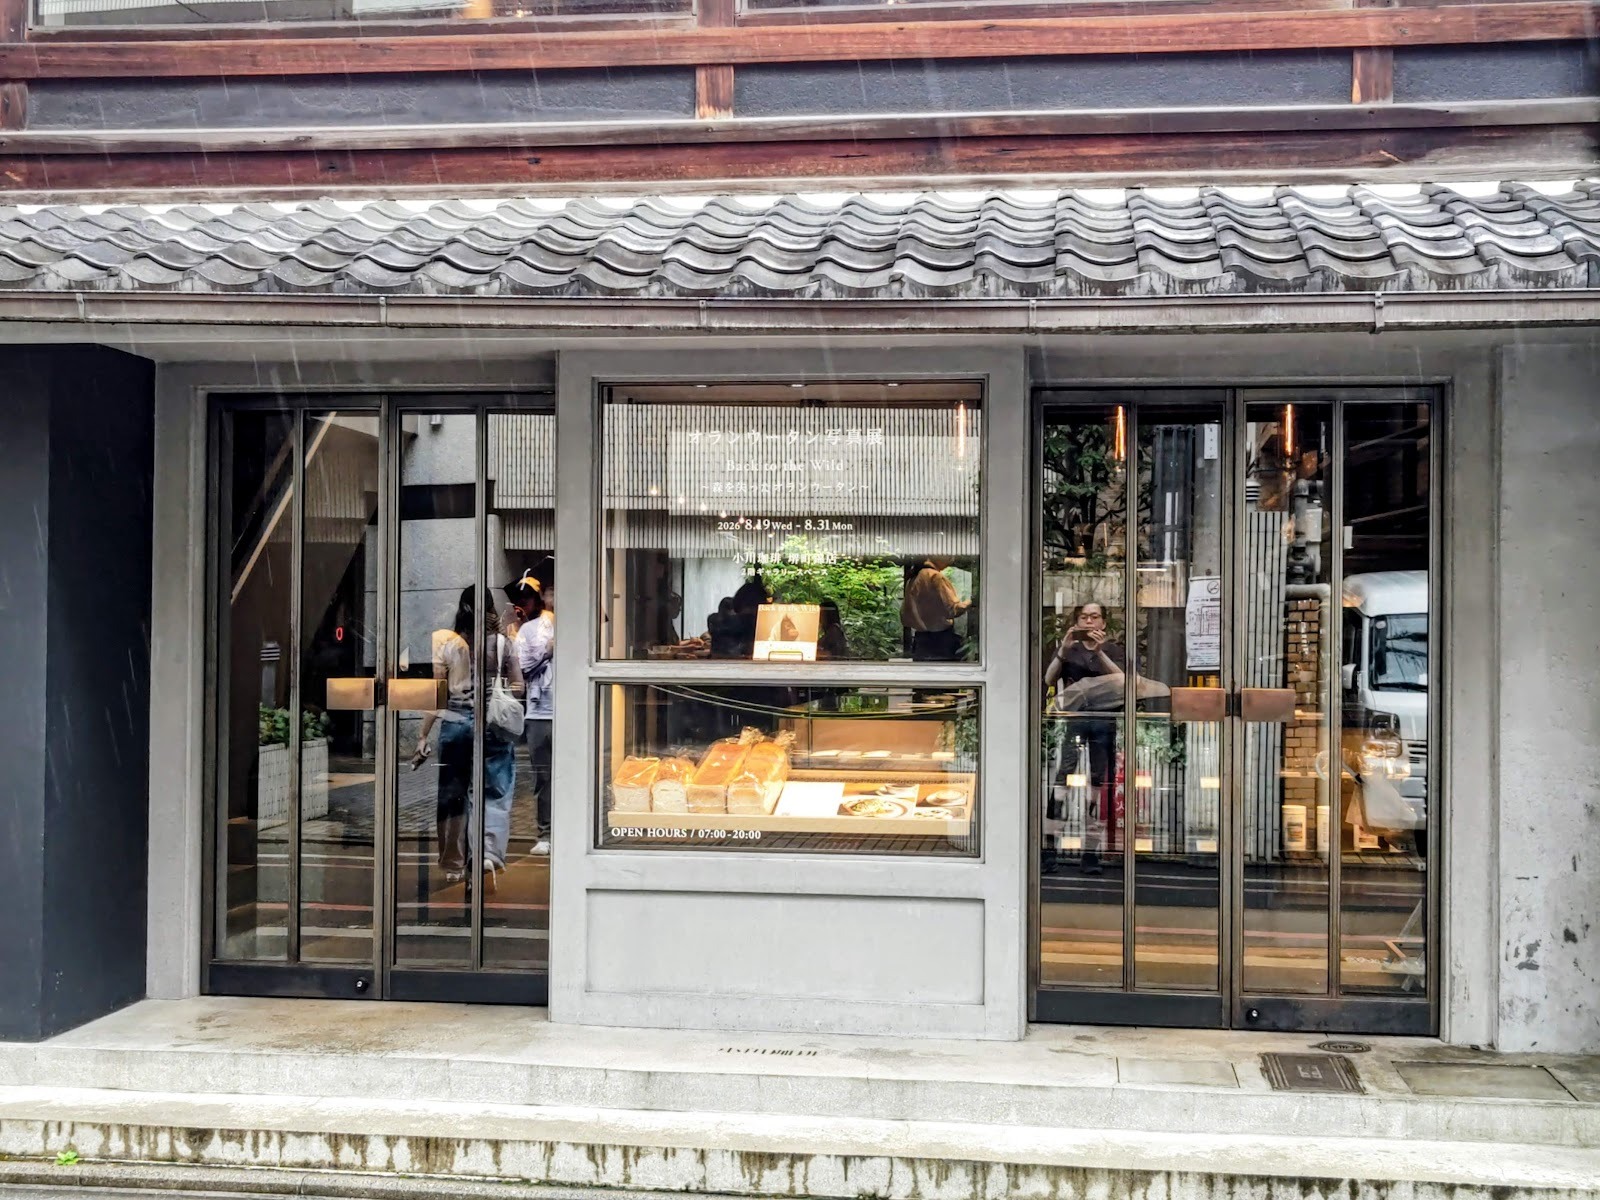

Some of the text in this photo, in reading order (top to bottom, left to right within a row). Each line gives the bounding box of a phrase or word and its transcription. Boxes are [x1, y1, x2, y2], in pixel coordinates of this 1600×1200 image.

[688, 428, 883, 446] オランウータン写真展
[726, 459, 844, 471] Back to the Wild
[717, 521, 740, 531] 2026
[732, 552, 782, 565] 小川珈琲
[611, 827, 643, 837] OPEN
[647, 828, 687, 838] HOURS
